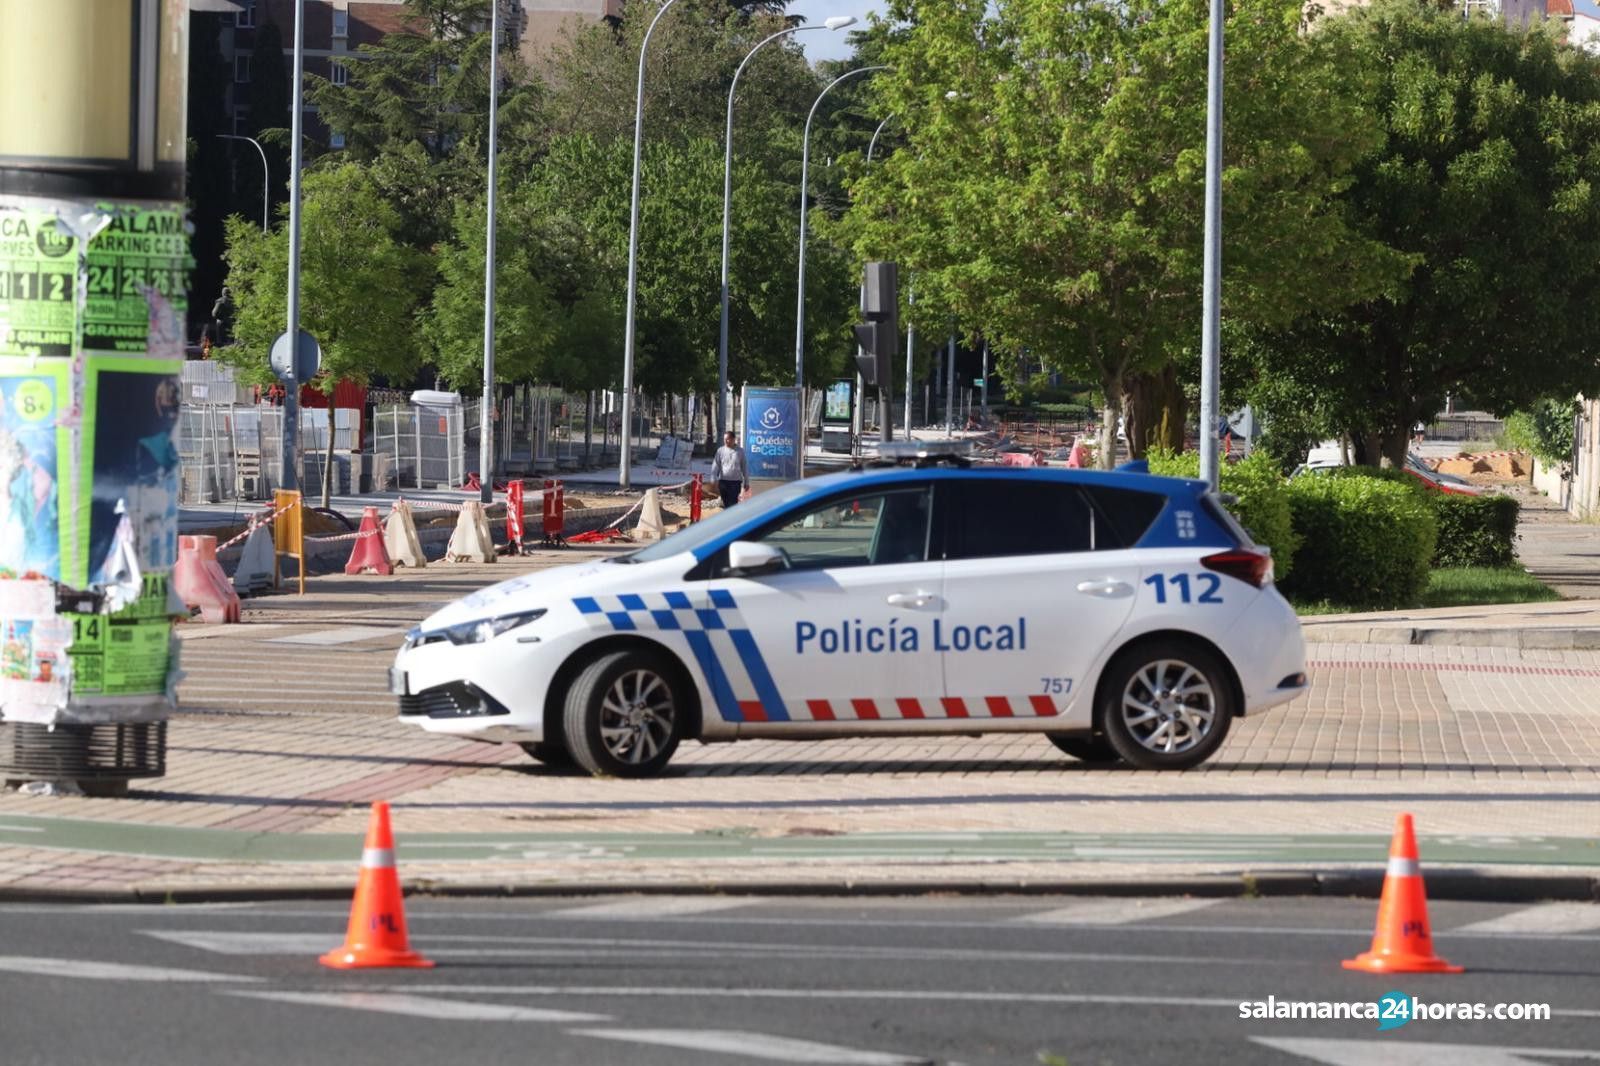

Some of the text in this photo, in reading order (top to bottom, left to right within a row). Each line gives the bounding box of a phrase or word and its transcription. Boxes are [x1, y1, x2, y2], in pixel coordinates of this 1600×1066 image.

[2, 218, 30, 237] CA
[20, 272, 30, 299] 1
[51, 272, 64, 299] 2
[88, 267, 115, 293] 24
[1144, 572, 1223, 604] 112
[75, 618, 99, 640] 14
[796, 617, 1026, 654] Policía Local
[1041, 678, 1072, 695] 757
